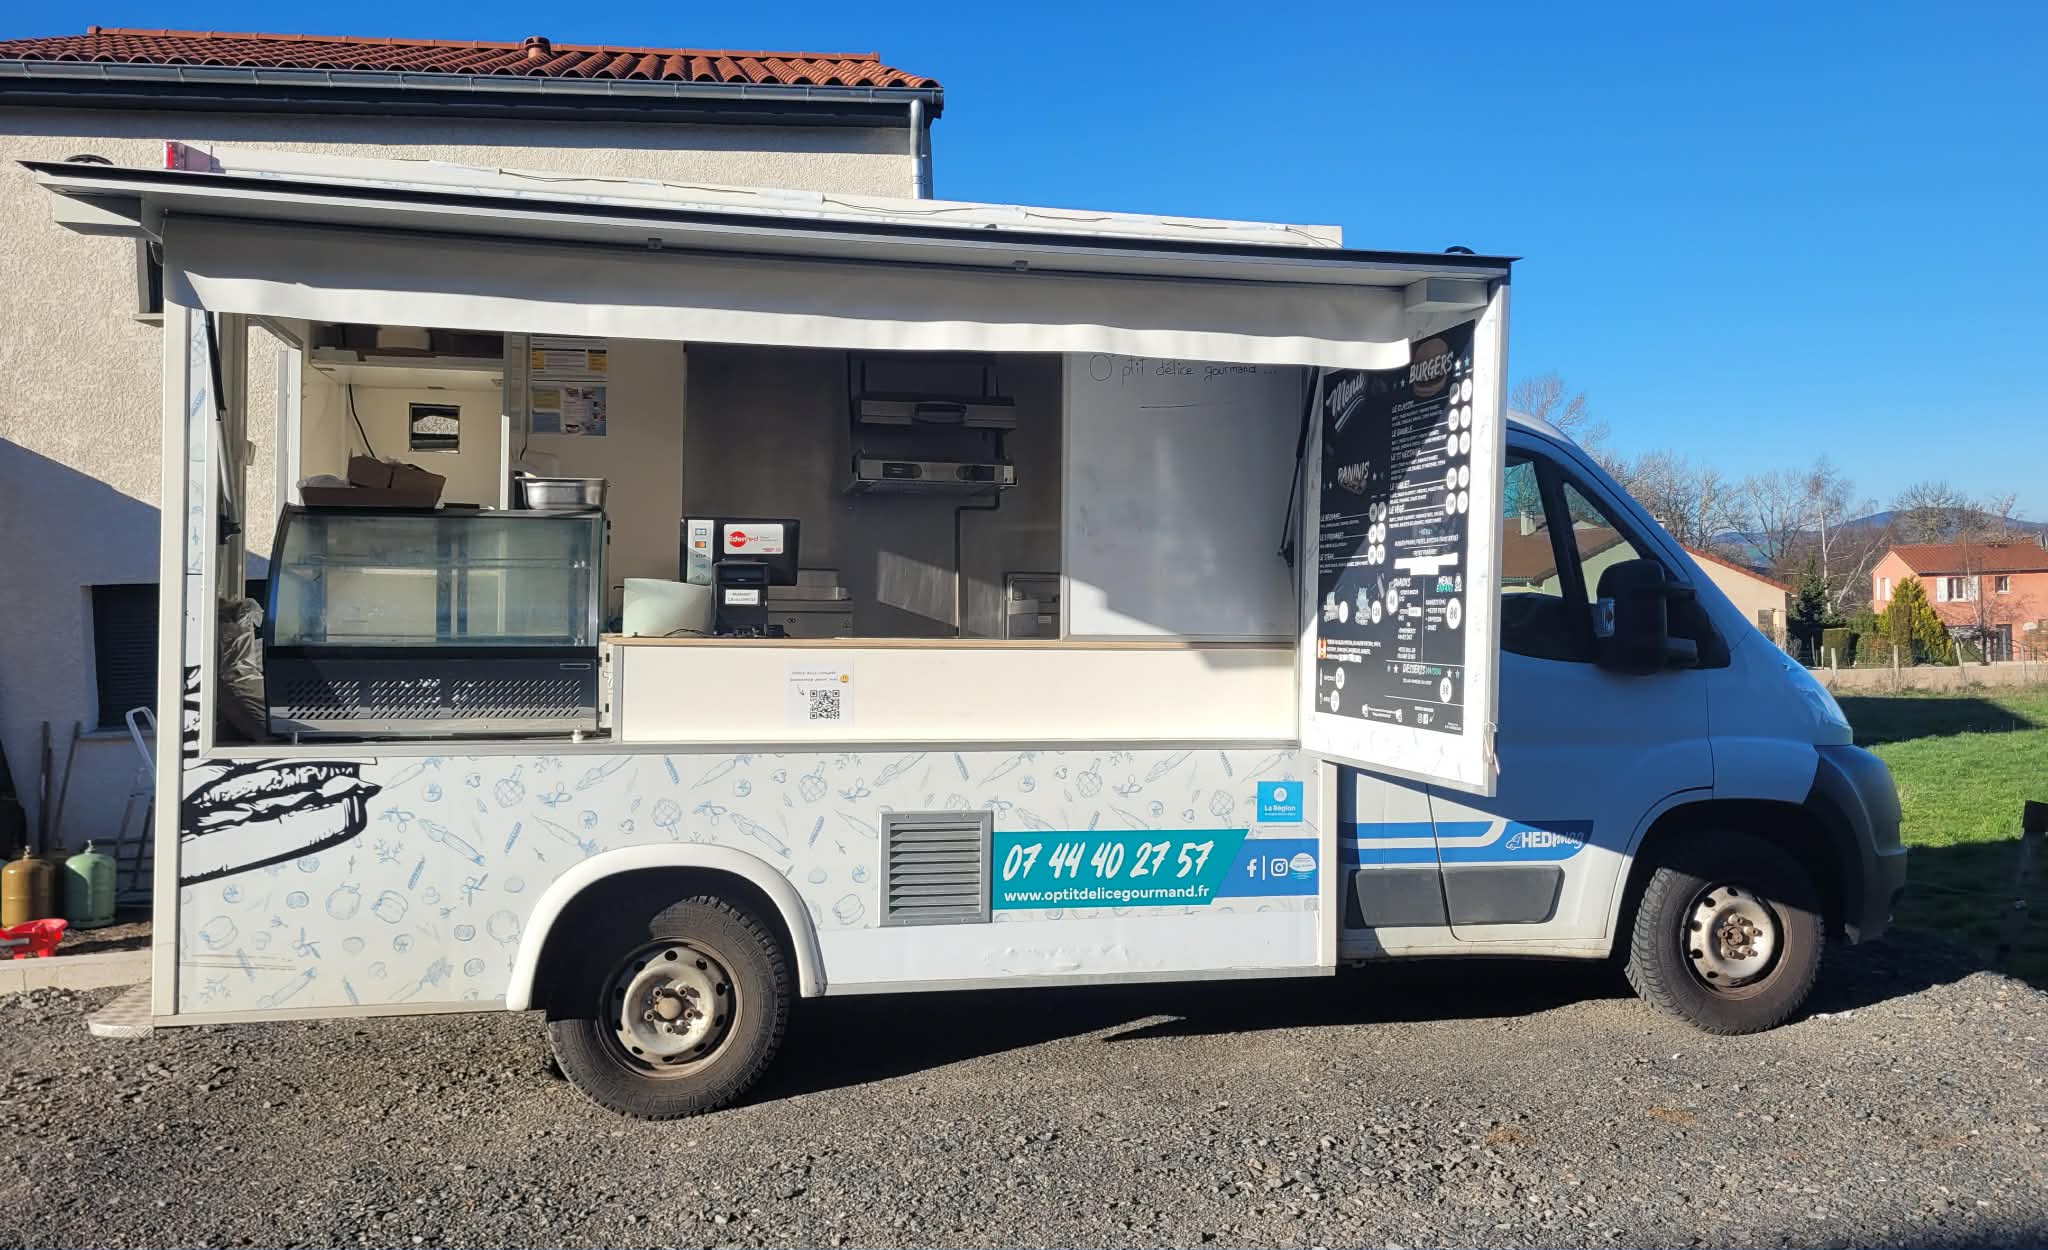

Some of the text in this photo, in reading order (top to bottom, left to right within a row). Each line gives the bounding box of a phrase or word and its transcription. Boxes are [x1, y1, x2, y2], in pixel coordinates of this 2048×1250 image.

[1408, 352, 1454, 384] BURGERS
[1325, 372, 1367, 417] Menu
[1337, 460, 1370, 481] PANINIS
[1264, 804, 1296, 813] La Région
[1002, 840, 1215, 881] 07 44 40 27 57
[1004, 884, 1210, 903] www.optitdelicegourmand.fr
